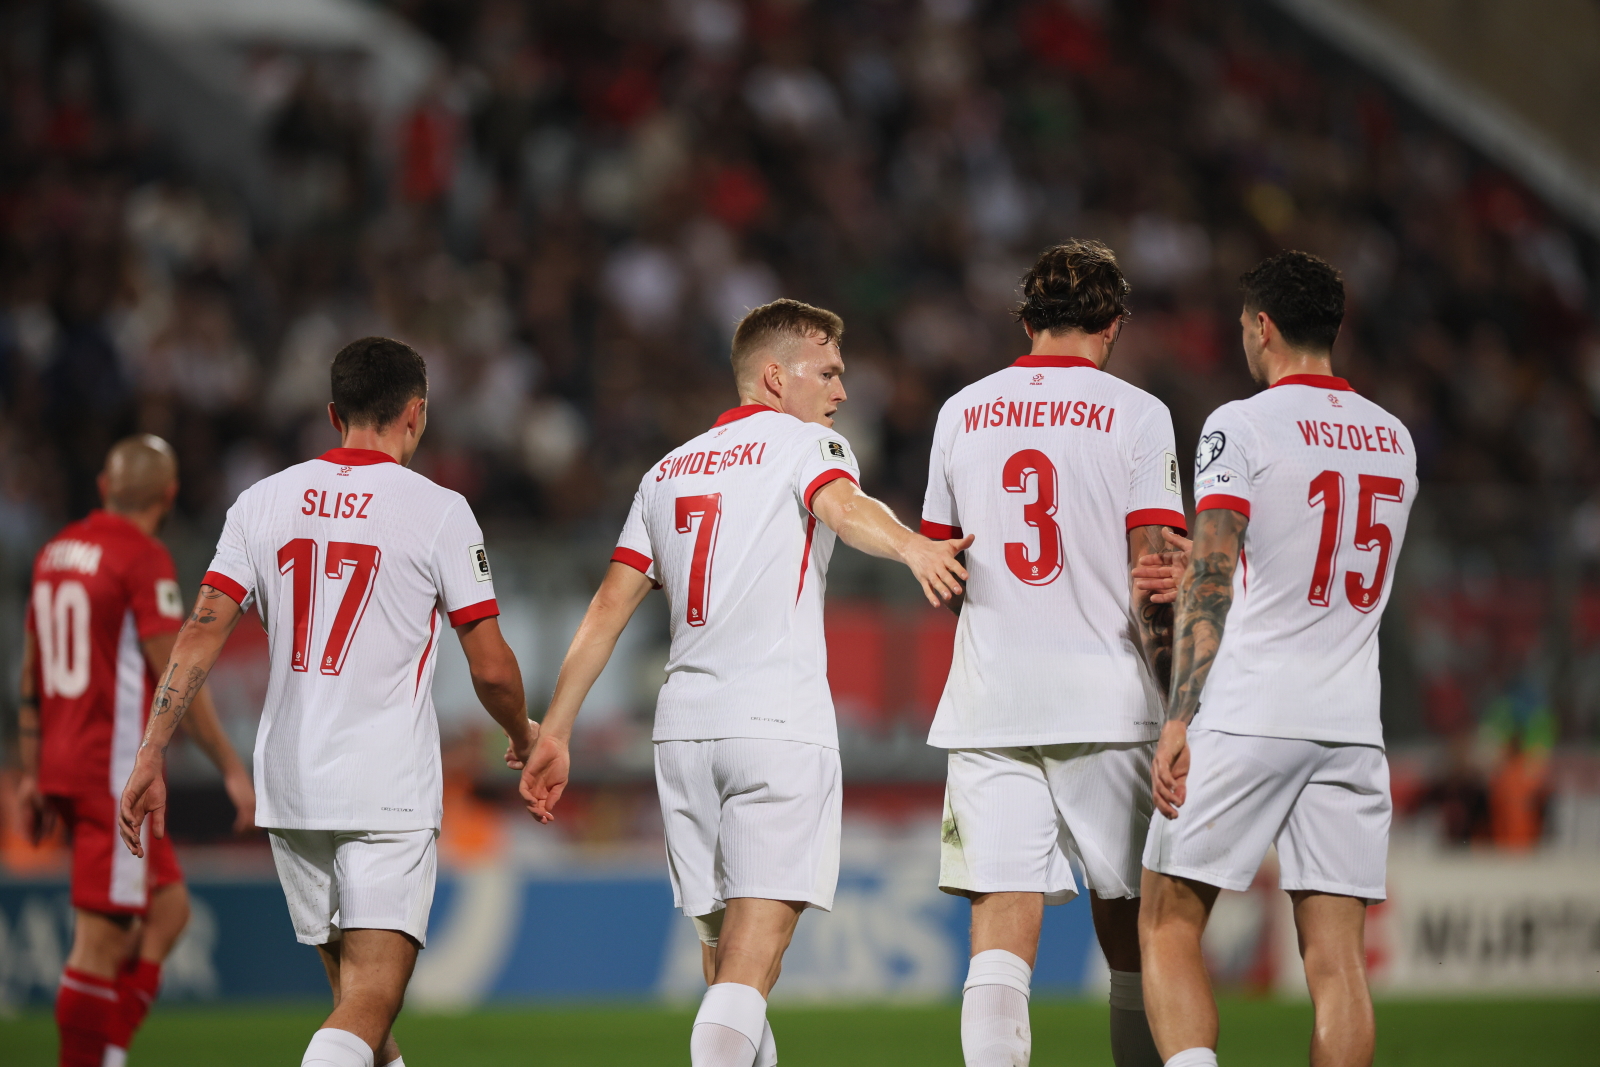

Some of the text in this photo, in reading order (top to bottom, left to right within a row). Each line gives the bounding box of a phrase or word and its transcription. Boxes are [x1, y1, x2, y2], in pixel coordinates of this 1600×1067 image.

[656, 442, 766, 482] ŚWIDERSKI
[964, 396, 1115, 433] WIŚNIEWSKI
[1296, 420, 1405, 455] WSZOŁEK
[301, 488, 374, 519] SLISZ
[675, 492, 723, 627] 7
[1002, 449, 1064, 586] 3
[1308, 470, 1404, 614] 15
[34, 580, 91, 698] 10
[277, 538, 382, 676] 17
